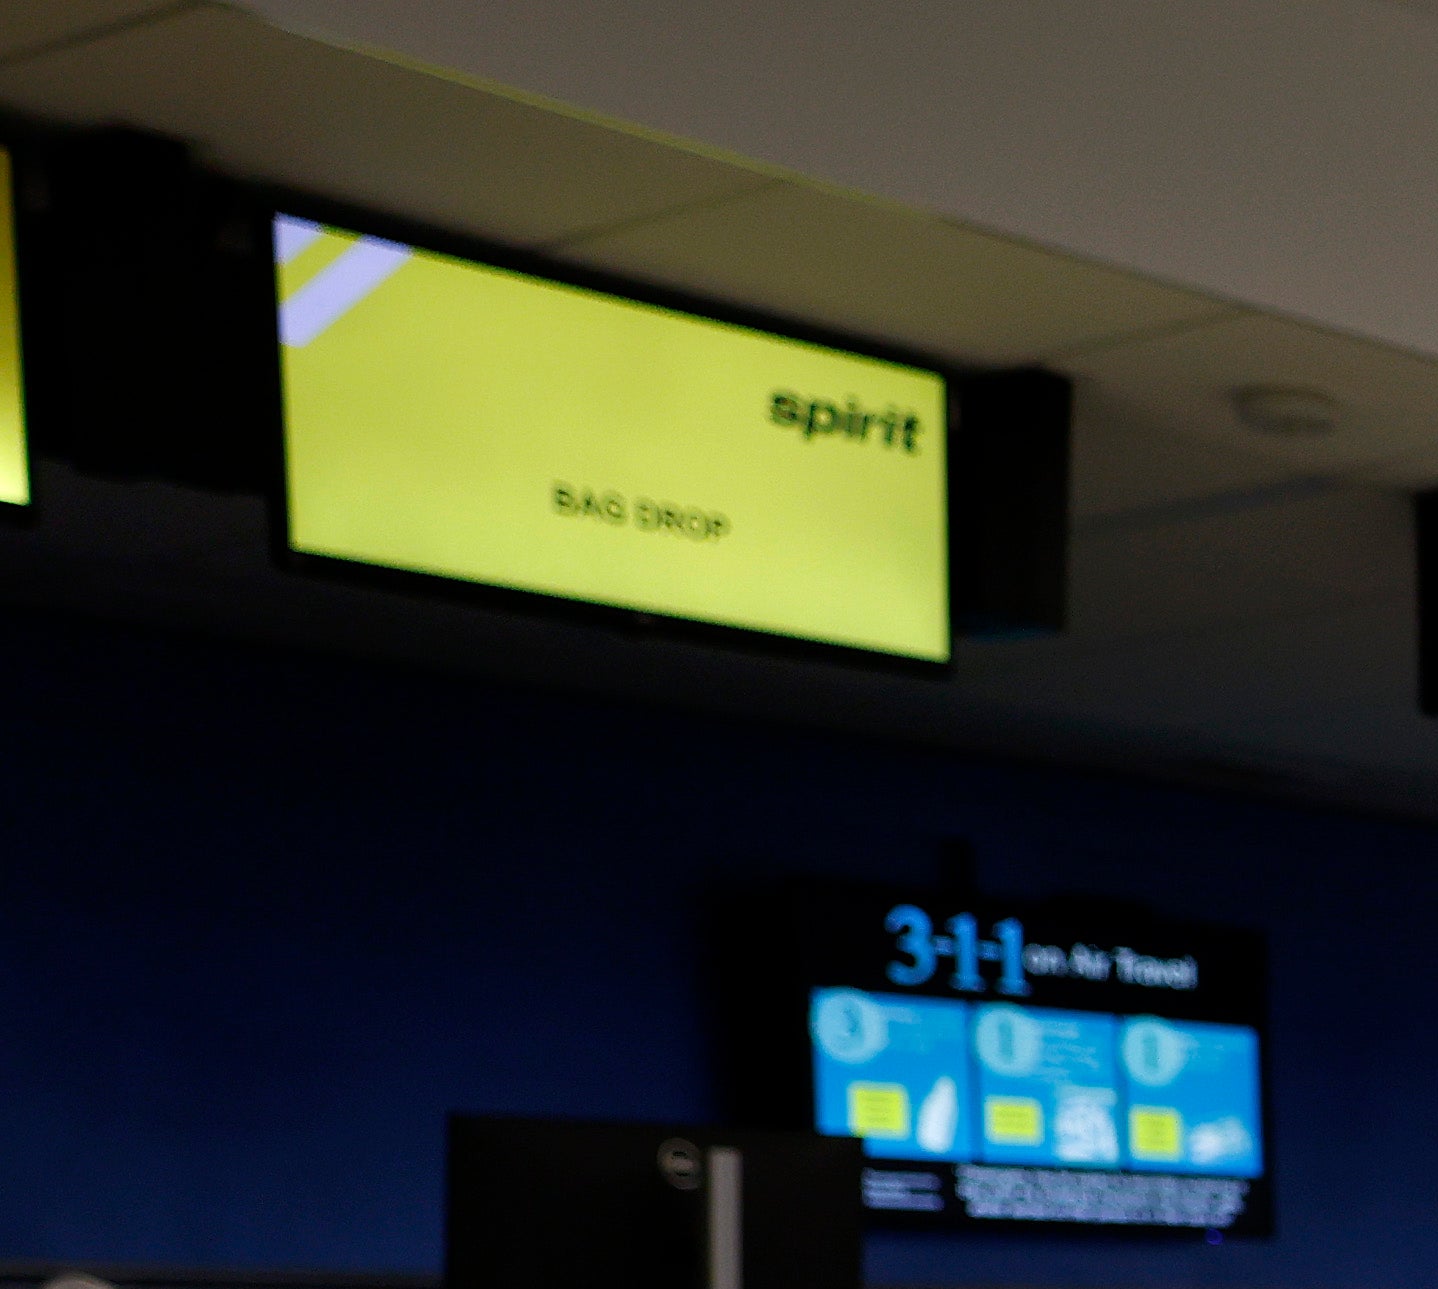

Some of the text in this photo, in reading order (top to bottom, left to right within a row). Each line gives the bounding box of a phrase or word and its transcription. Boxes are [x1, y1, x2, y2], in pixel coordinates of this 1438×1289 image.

[767, 388, 922, 455] spirit
[551, 481, 731, 545] BAG DROP
